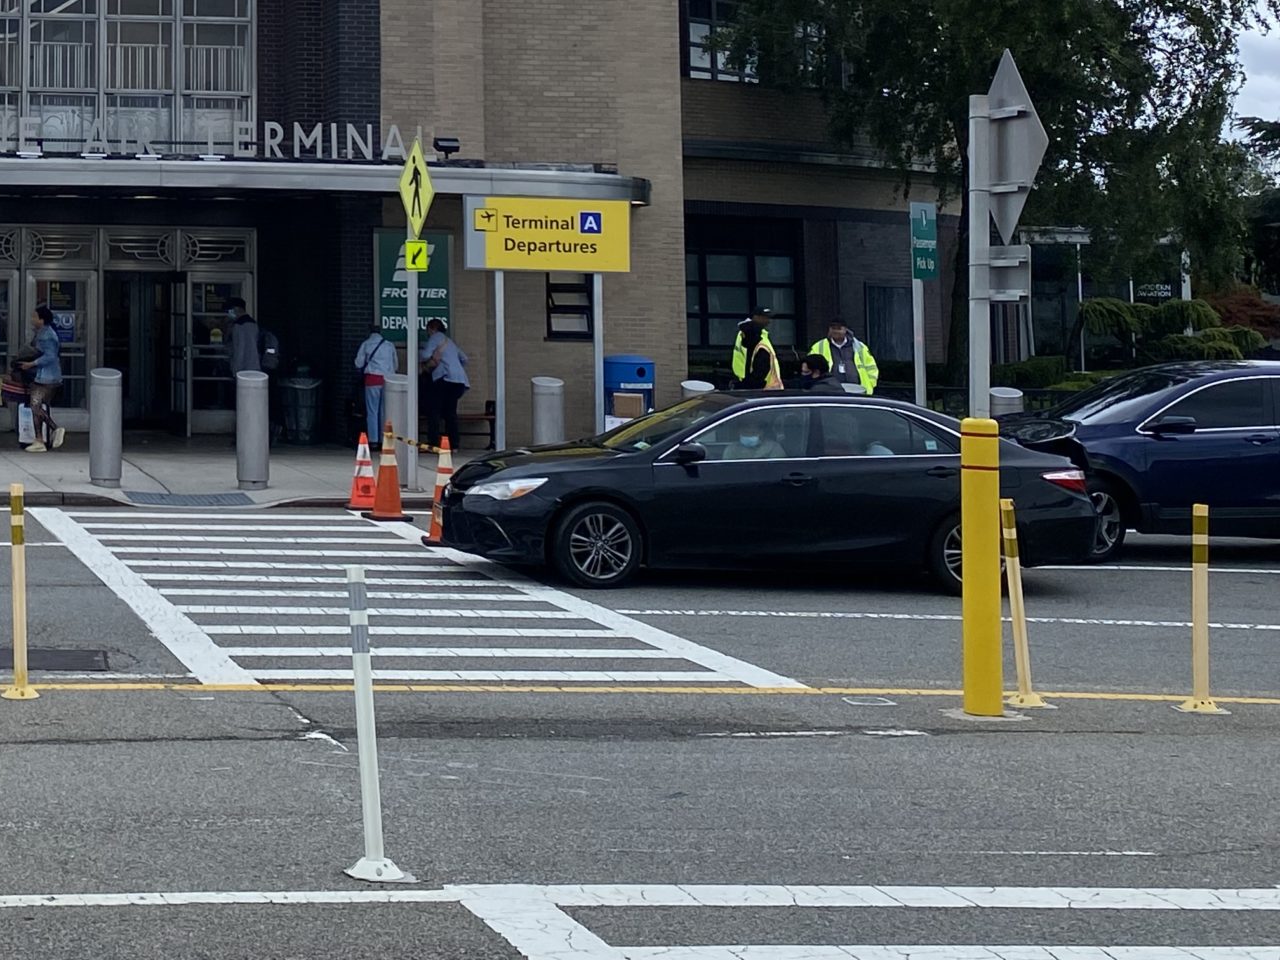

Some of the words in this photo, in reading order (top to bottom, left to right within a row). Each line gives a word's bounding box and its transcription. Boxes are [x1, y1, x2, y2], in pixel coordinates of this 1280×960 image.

[83, 118, 156, 155] AIR
[503, 215, 574, 230] Terminal
[584, 215, 598, 231] A
[504, 237, 598, 255] Departures
[382, 287, 447, 299] FROTIER
